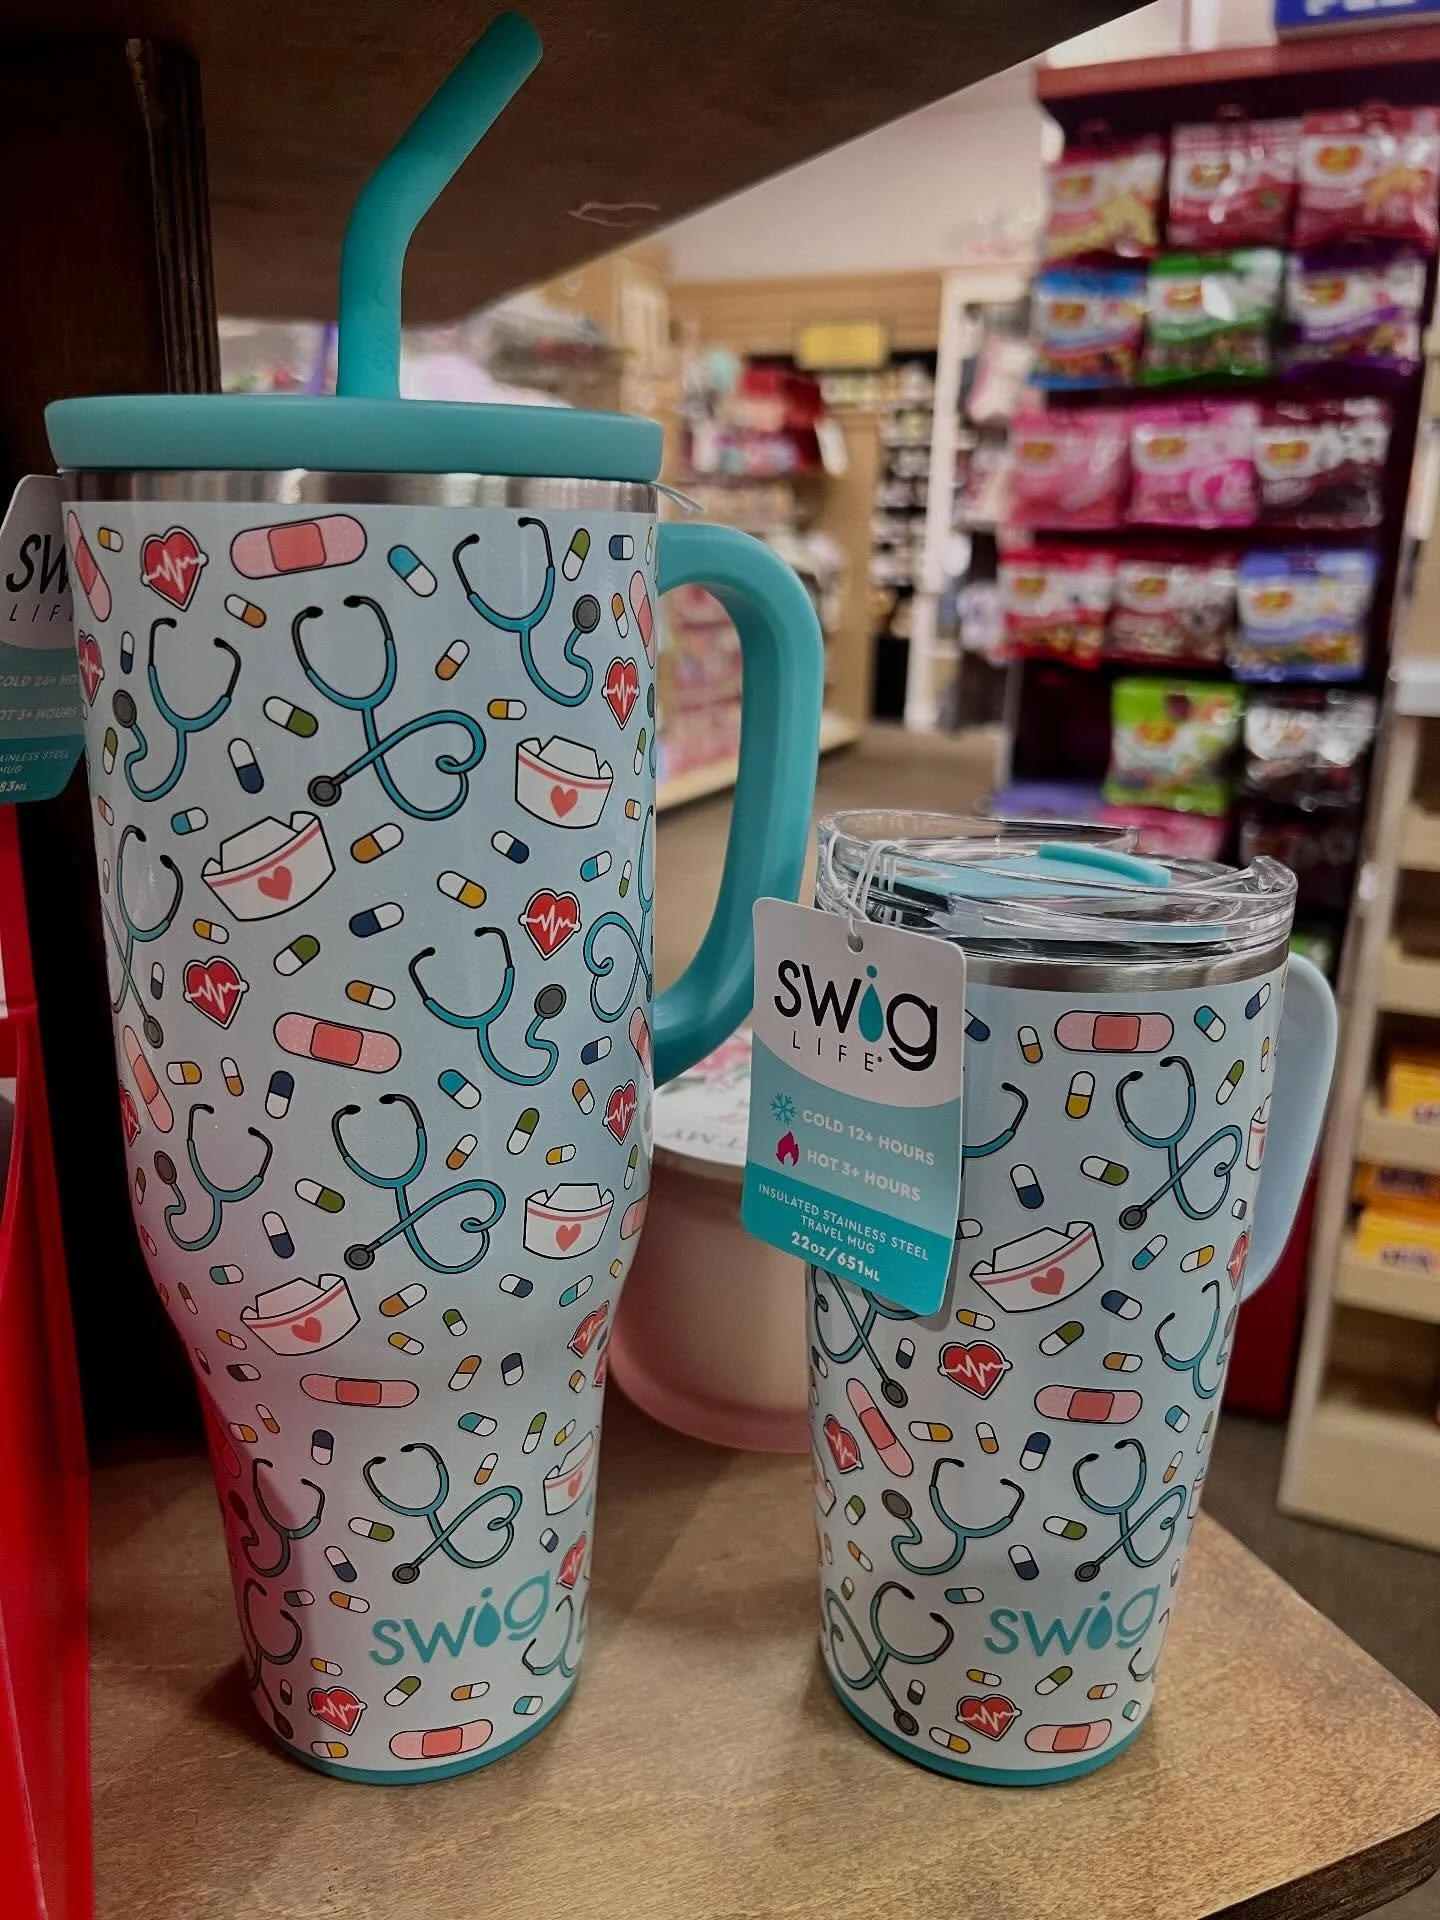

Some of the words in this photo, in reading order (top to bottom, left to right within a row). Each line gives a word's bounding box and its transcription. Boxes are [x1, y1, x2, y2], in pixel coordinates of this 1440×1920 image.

[9, 603, 73, 623] LIF
[41, 749, 69, 761] STEEL
[803, 1109, 844, 1133] COLD
[848, 1125, 873, 1143] 12+
[878, 1134, 936, 1167] HOURS
[807, 1148, 839, 1172] HOT
[841, 1162, 860, 1178] 3+
[864, 1169, 921, 1202] HOURS
[759, 1183, 819, 1216] INSULATED
[823, 1210, 887, 1243] STAINLESS
[890, 1236, 928, 1261] STEEL
[801, 1214, 843, 1242] TRAVEL
[847, 1235, 875, 1254] MUG
